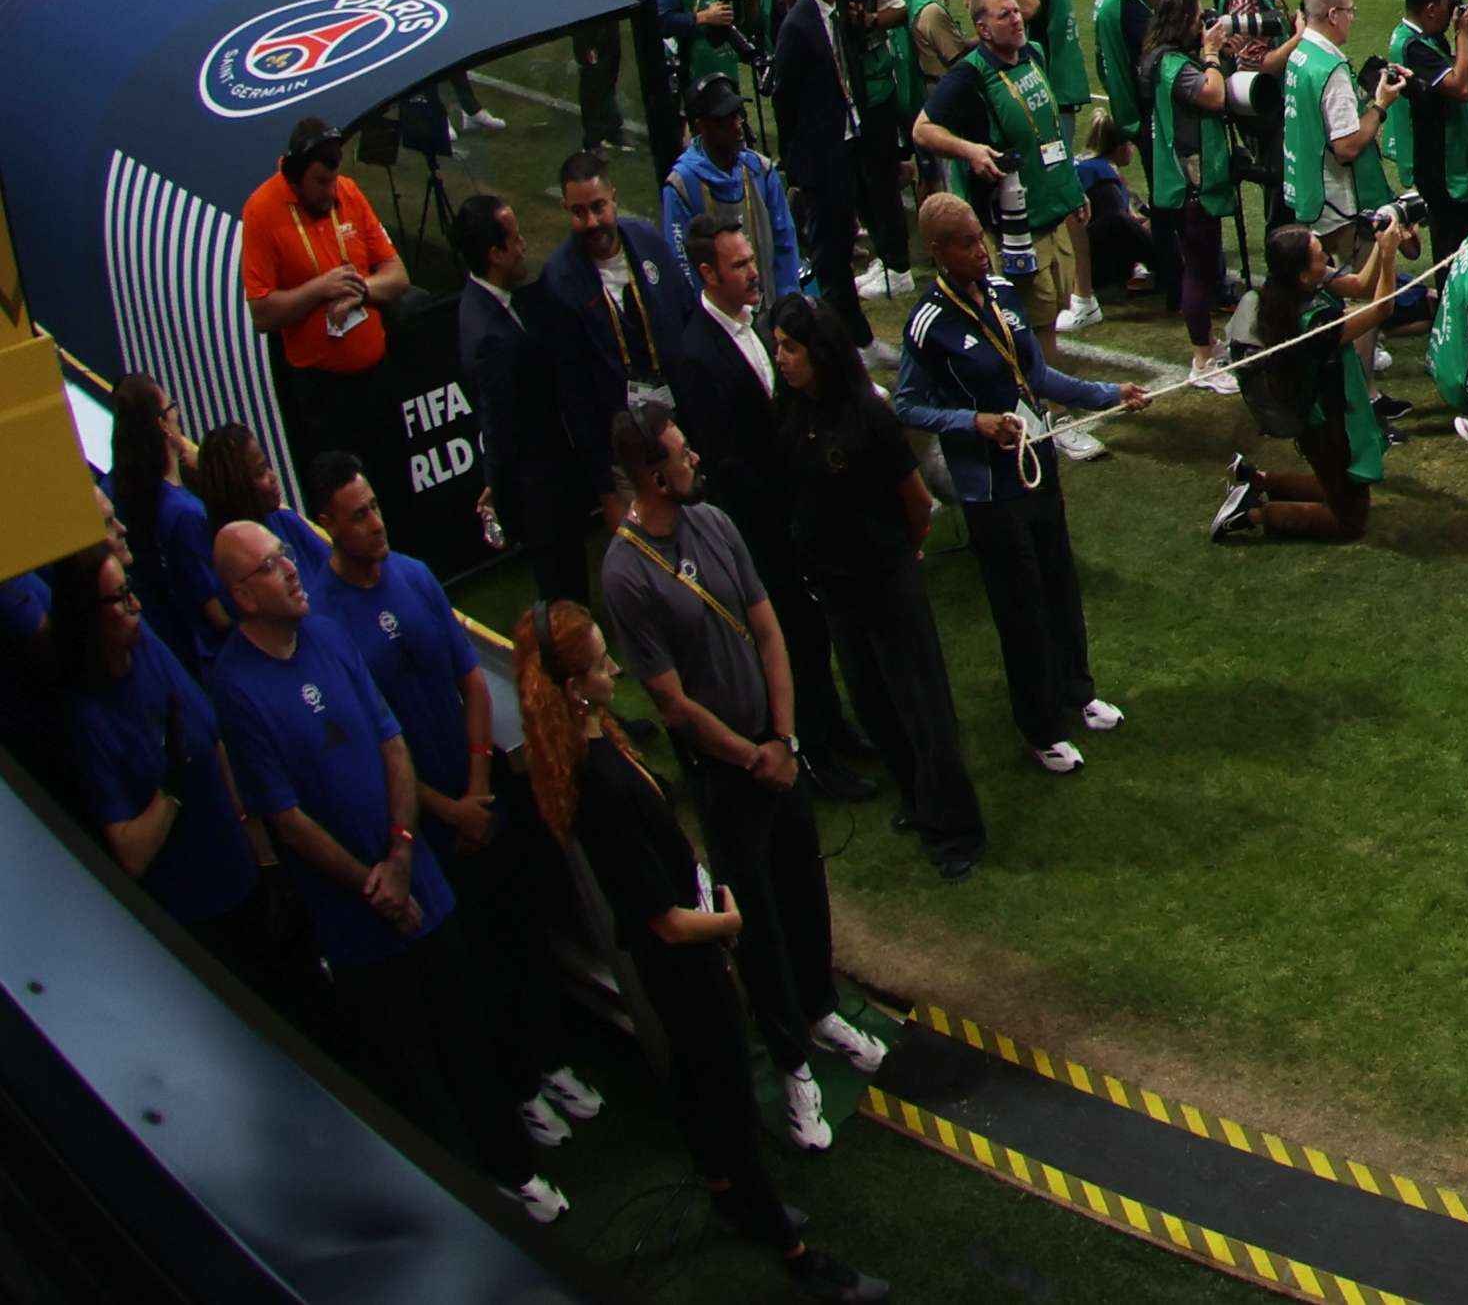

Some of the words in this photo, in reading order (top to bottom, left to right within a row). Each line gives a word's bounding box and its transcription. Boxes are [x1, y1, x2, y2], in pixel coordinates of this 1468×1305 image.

[224, 48, 239, 86] SAINT
[1013, 70, 1043, 95] HOTO
[229, 77, 308, 101] GERMAIN
[1026, 91, 1050, 113] 629
[401, 380, 473, 439] FIFA
[410, 437, 474, 493] RLD
